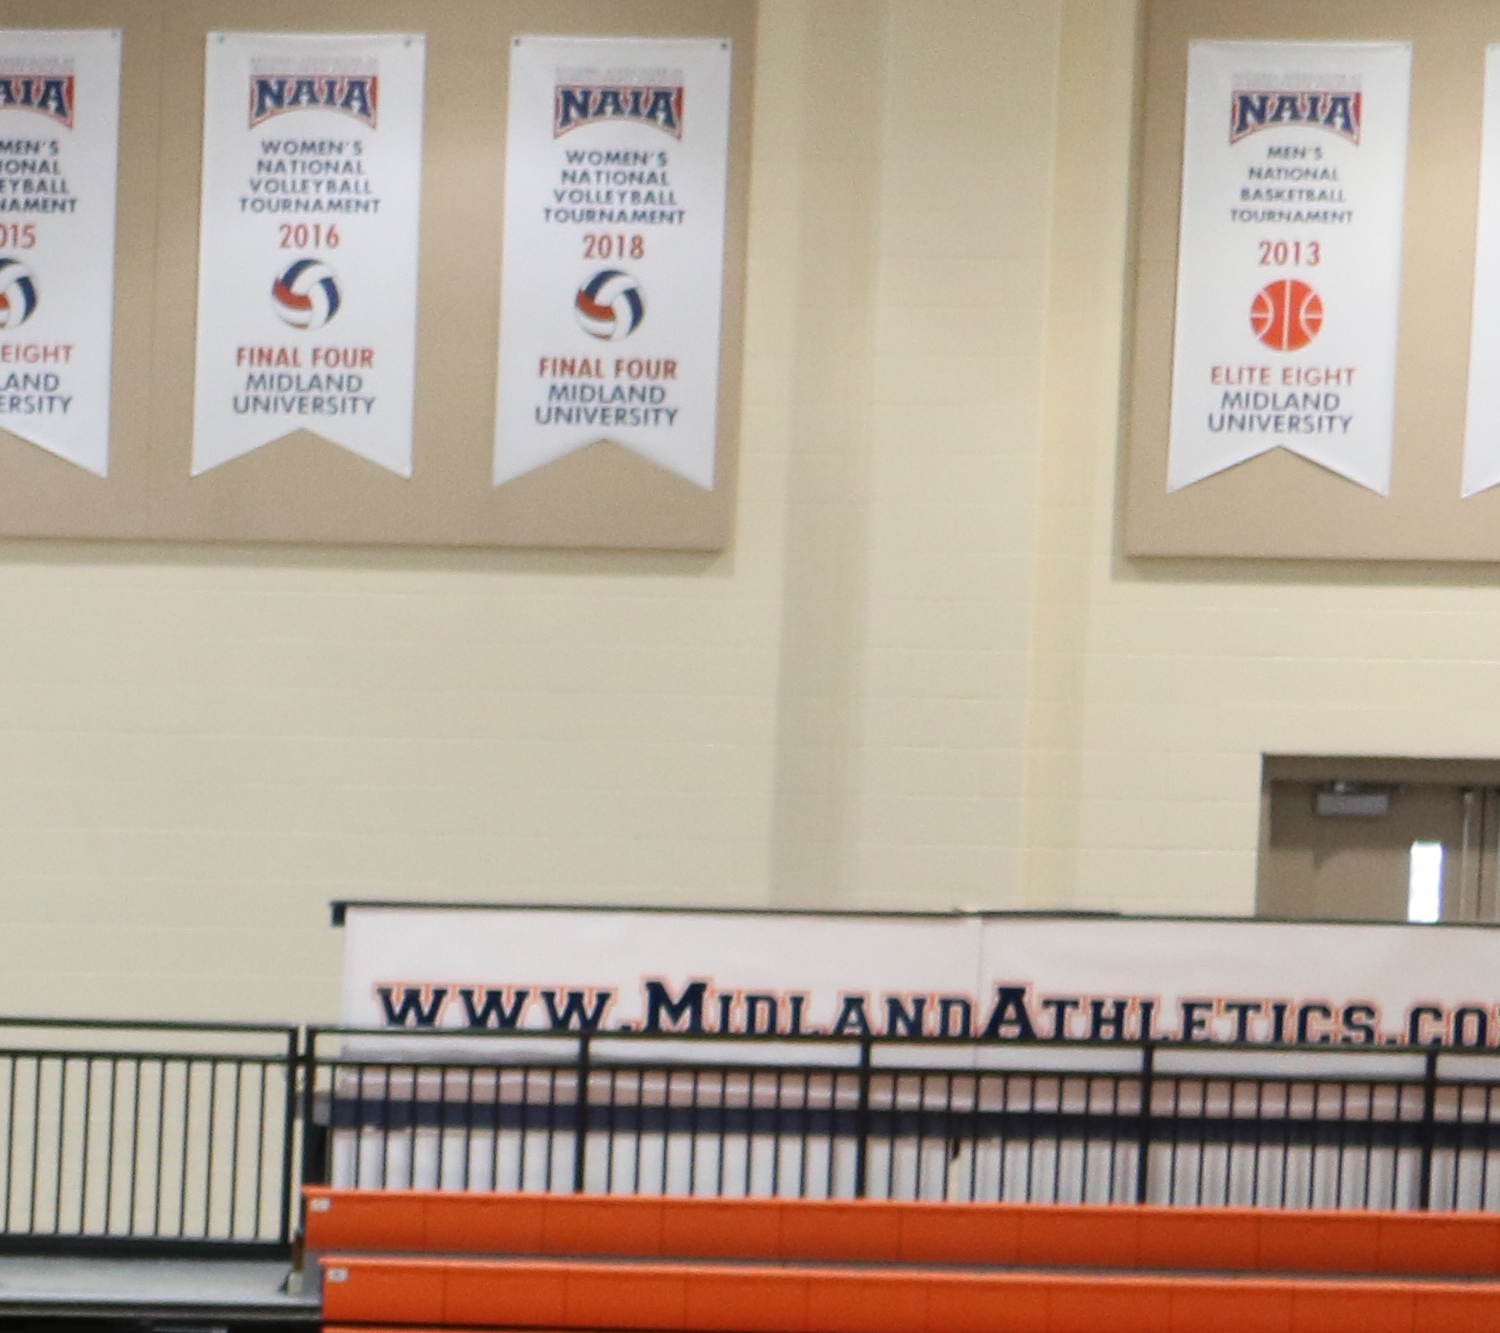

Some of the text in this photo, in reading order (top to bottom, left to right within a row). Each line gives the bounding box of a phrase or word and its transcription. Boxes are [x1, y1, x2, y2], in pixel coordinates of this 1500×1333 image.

[253, 78, 373, 119] NAIA
[559, 88, 679, 129] NAIA
[1234, 93, 1356, 135] NAIA
[260, 139, 363, 156] WOMEN'S
[256, 158, 364, 175] NATIONAL
[565, 150, 668, 167] WOMEN'S
[560, 169, 669, 187] NATIONAL
[1247, 166, 1339, 182] NATIONAL
[248, 178, 372, 194] VOLLEYBALL
[1240, 187, 1345, 203] BASKETBALL
[238, 197, 381, 214] TOURNAMENT
[553, 189, 678, 206] VOLLEYBALL
[543, 208, 687, 225] TOURNAMENT
[1230, 209, 1354, 225] TOURNAMENT
[278, 223, 341, 249] 2016
[583, 234, 645, 260] 2018
[1257, 240, 1321, 267] 2013
[0, 343, 74, 364] EIGHT
[236, 347, 375, 368] FINAL FOUR
[538, 357, 678, 381] FINAL FOUR
[1210, 366, 1356, 387] ELITE EIGHT
[245, 373, 363, 394] MIDLAND
[547, 384, 666, 405] MIDLAND
[1220, 391, 1340, 413] MIDLAND
[232, 396, 376, 416] UNIVERSITY
[535, 406, 679, 427] UNIVERSITY
[1207, 413, 1354, 434] UNIVERSITY
